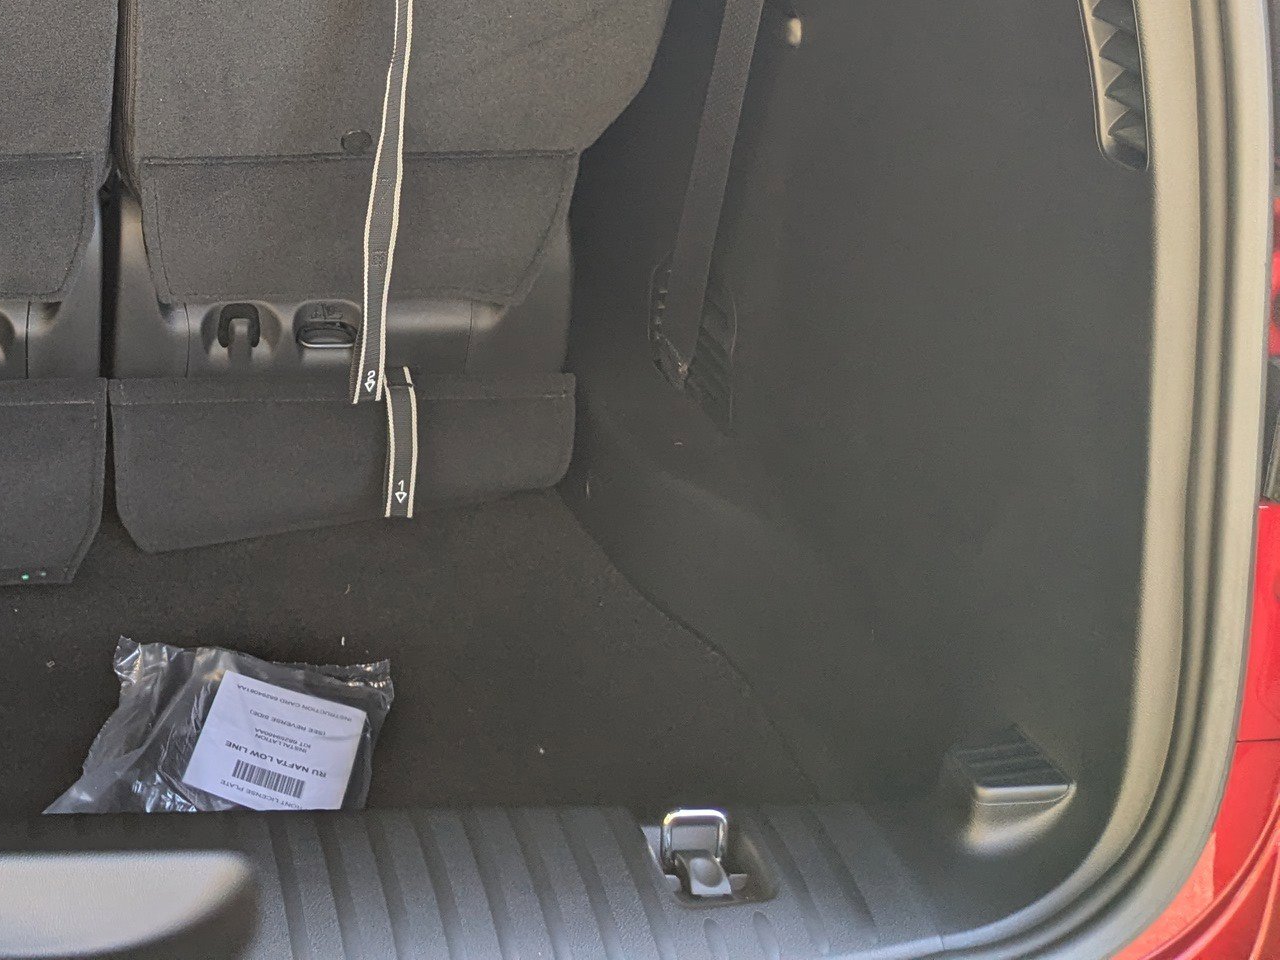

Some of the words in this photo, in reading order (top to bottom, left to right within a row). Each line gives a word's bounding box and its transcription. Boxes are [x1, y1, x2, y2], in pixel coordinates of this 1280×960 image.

[397, 479, 404, 491] 1
[279, 698, 301, 709] CARD
[249, 709, 270, 721] SIDE)
[301, 704, 353, 723] INSTRUCTION
[269, 716, 307, 731] REVERSE
[225, 740, 248, 754] LINE
[255, 733, 307, 754] INSTALLATION
[300, 741, 311, 749] KIT
[250, 750, 273, 762] LOW
[276, 758, 309, 773] NAFTA
[311, 770, 327, 778] RU
[220, 779, 244, 792] PLATE
[245, 787, 279, 803] LICENSE
